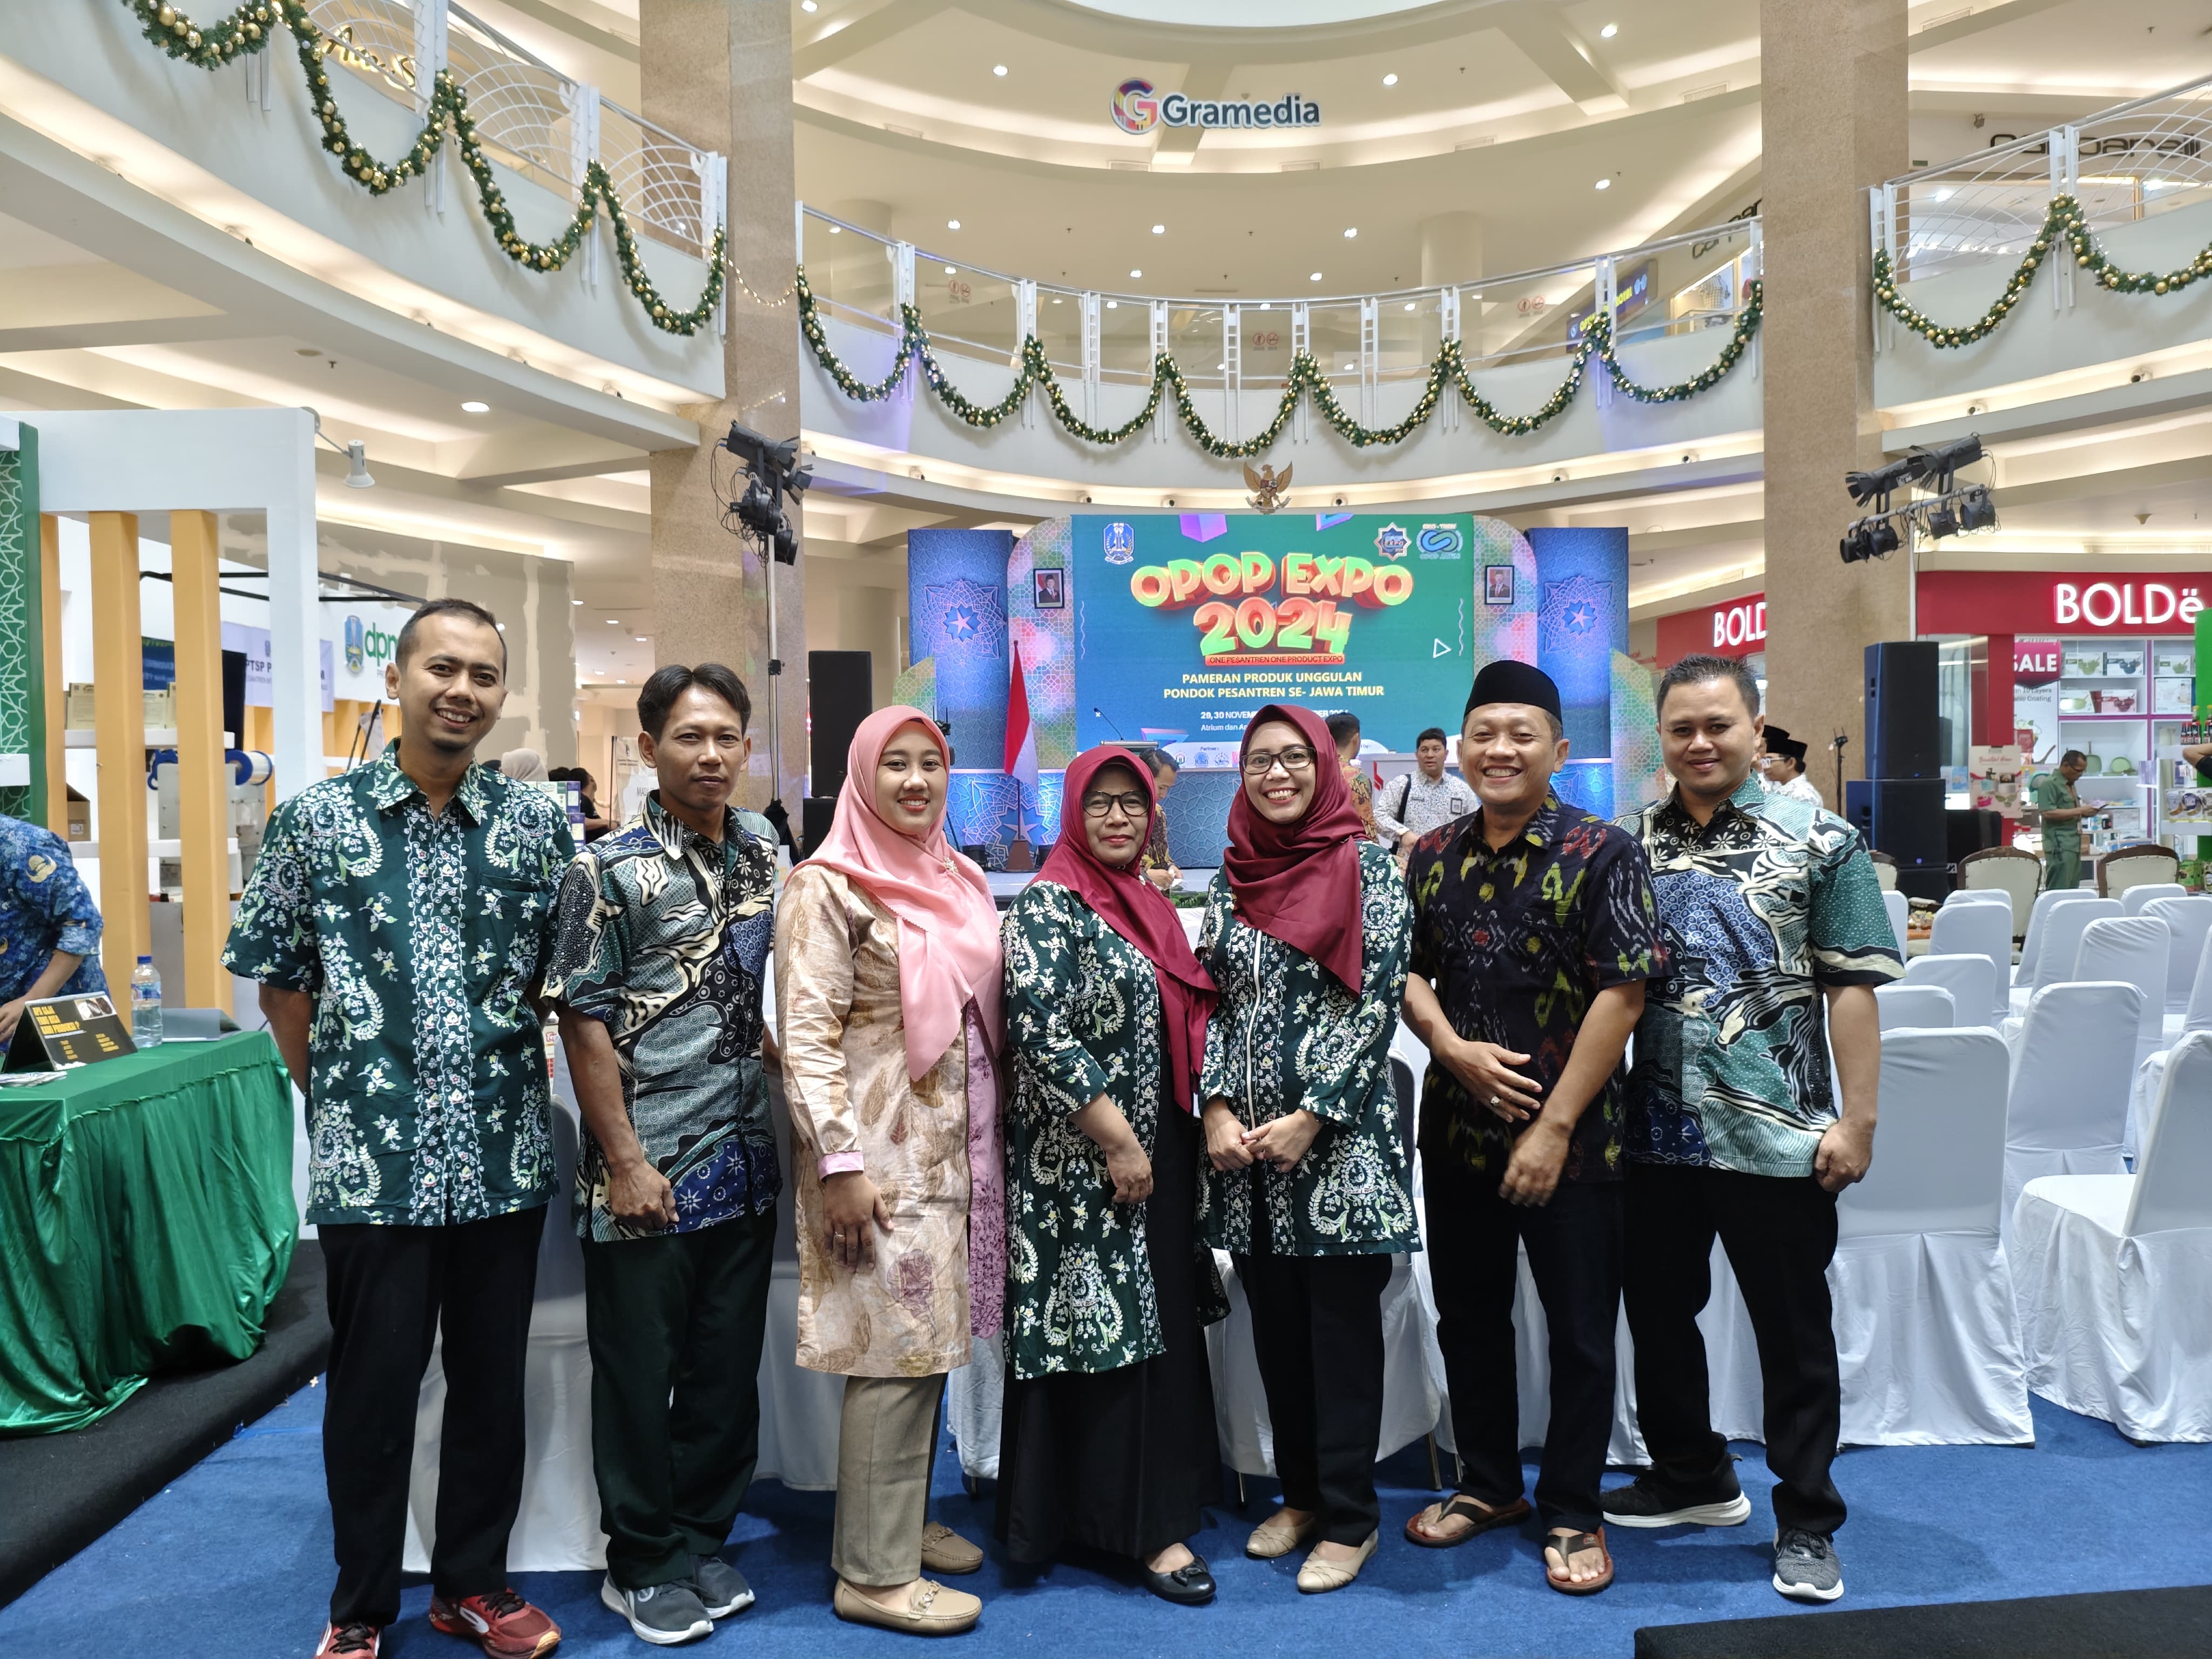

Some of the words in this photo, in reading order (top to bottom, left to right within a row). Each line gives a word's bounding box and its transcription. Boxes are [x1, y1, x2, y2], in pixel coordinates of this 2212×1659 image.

[1161, 93, 1320, 126] Gramedia
[1130, 552, 1276, 608] OPOP
[1280, 552, 1414, 609] EXPO
[2054, 583, 2204, 626] BOLDë
[1193, 596, 1353, 656] 2024
[1164, 688, 1215, 698] PONDOK
[1218, 687, 1285, 698] PESANTREN
[1309, 686, 1343, 697] JAWA
[1345, 685, 1384, 696] TIMUR
[1183, 673, 1240, 684] PAMERAN
[1244, 673, 1292, 683] PRODUK
[1296, 672, 1362, 683] UNGGULAN
